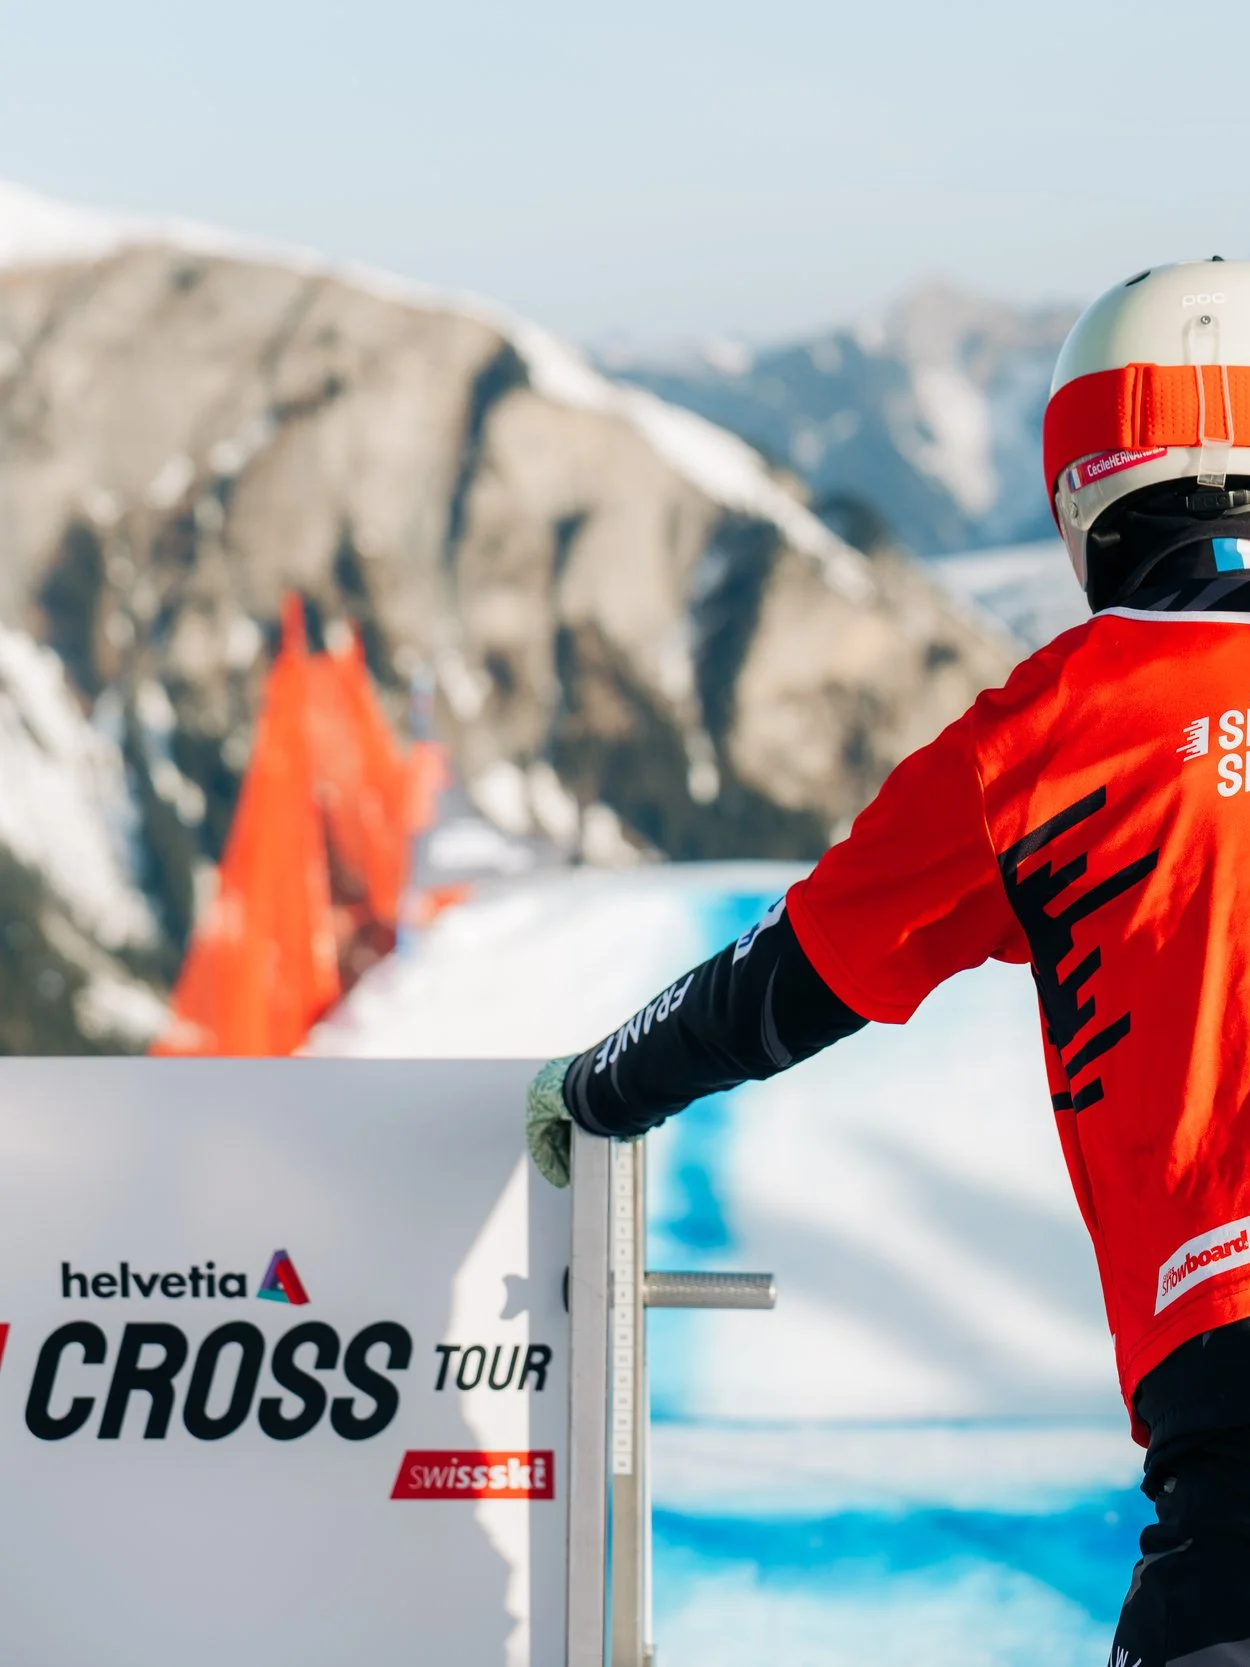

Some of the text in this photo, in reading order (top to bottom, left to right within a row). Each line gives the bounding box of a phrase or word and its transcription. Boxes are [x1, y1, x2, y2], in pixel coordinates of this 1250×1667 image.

[594, 973, 695, 1074] FRANCE
[61, 1262, 247, 1299] helvetia
[25, 1320, 553, 1441] CROSS TOUR
